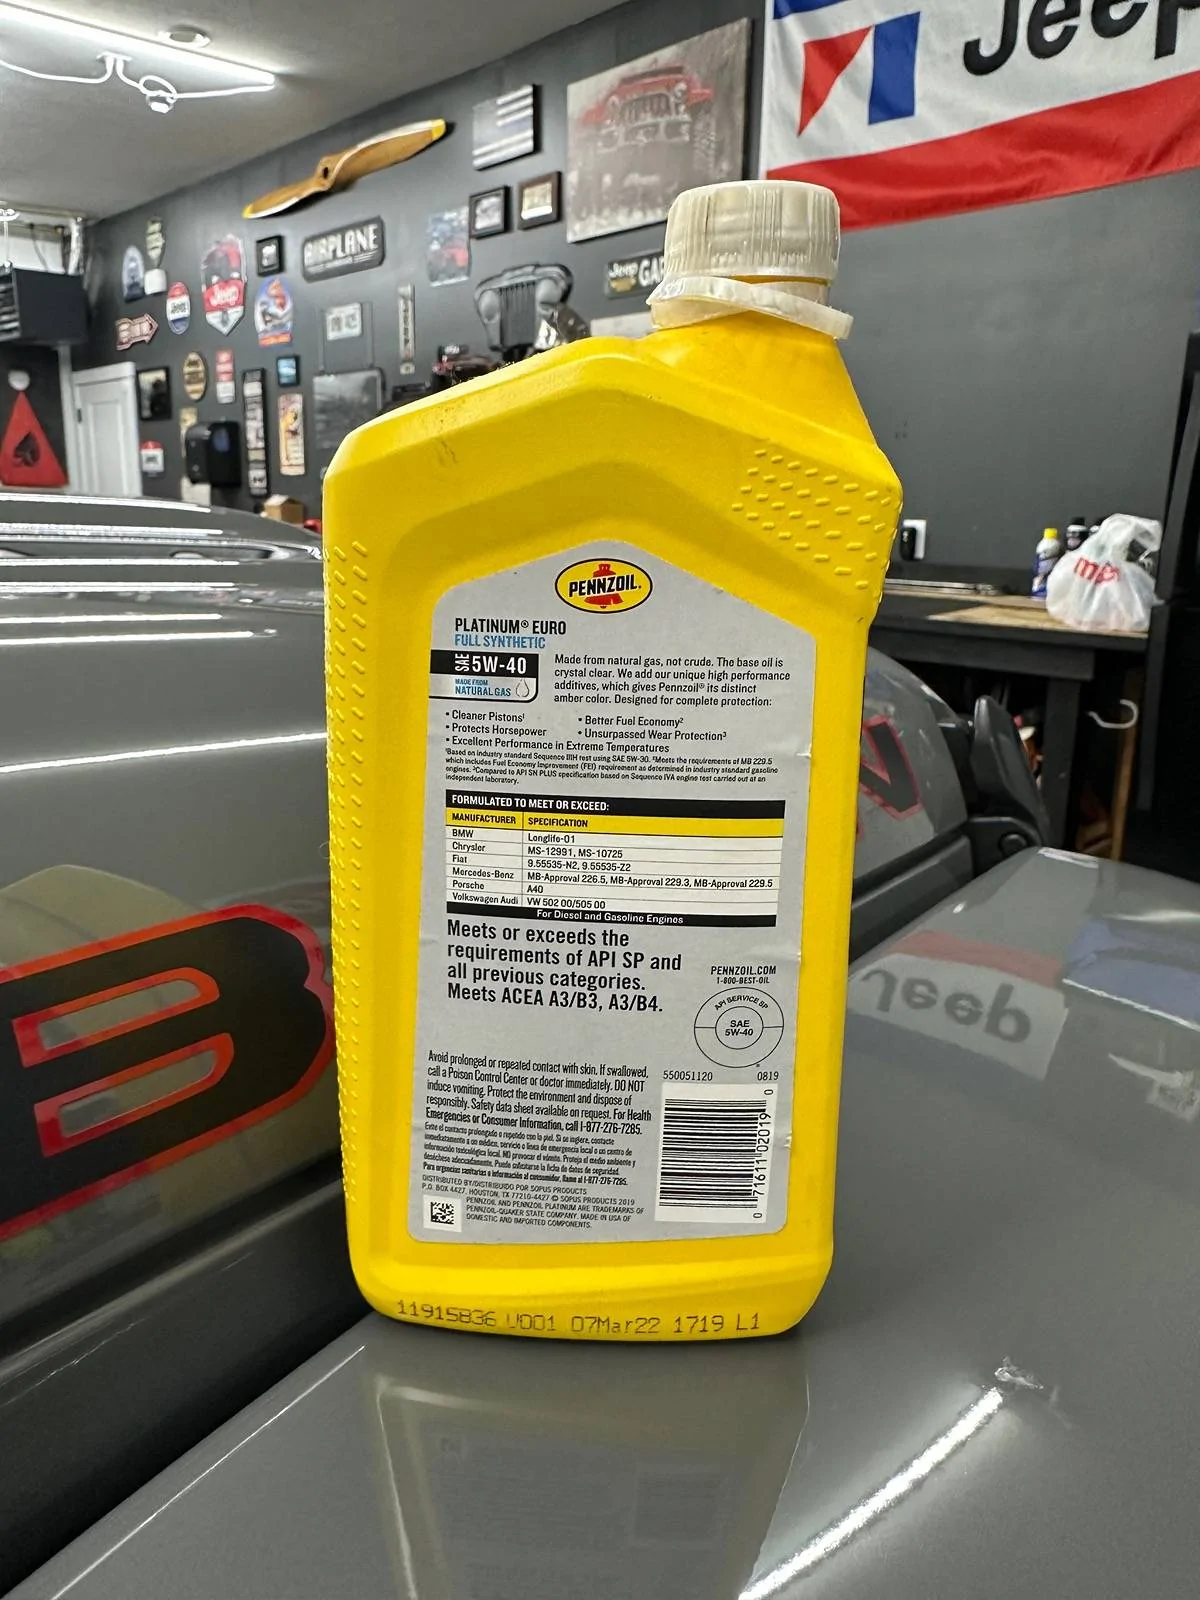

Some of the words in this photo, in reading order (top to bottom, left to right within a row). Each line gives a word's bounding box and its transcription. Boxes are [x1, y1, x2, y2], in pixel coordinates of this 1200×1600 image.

[532, 620, 567, 635] EURO
[454, 633, 481, 647] FULL
[483, 635, 546, 649] SYNTHETIC
[454, 653, 470, 672] SAE
[472, 655, 527, 674] 5W-40
[554, 654, 581, 665] Made
[583, 654, 605, 665] from
[607, 655, 641, 666] natural
[644, 657, 664, 669] gas,
[666, 657, 682, 666] not
[684, 656, 714, 667] crude.
[717, 656, 735, 667] The
[736, 657, 759, 668] base
[761, 658, 773, 668] oil
[775, 658, 784, 668] is
[554, 668, 587, 680] crystal
[588, 668, 615, 679] clear.
[617, 669, 633, 679] We
[635, 669, 653, 679] add
[654, 671, 671, 679] our
[673, 670, 706, 682] unique
[707, 670, 729, 682] high
[730, 671, 791, 682] performance
[455, 686, 494, 696] NATURAL
[495, 687, 512, 697] GAS
[554, 682, 600, 692] additives,
[602, 682, 630, 692] which
[631, 682, 657, 694] gives
[707, 683, 719, 693] its
[721, 683, 757, 693] distinct
[554, 694, 584, 703] amber
[585, 694, 612, 704] color.
[614, 694, 658, 706] Designed
[660, 695, 674, 705] for
[675, 696, 719, 707] complete
[720, 696, 772, 708] protection:
[451, 710, 486, 721] Cleaner
[584, 716, 613, 726] Better
[616, 716, 636, 726] Fuel
[452, 723, 490, 734] Protects
[492, 725, 547, 737] Horsepower
[584, 729, 646, 741] Unsurpassed
[648, 730, 672, 740] Wear
[452, 735, 493, 747] Excellent
[495, 738, 553, 750] Performance
[555, 740, 564, 750] in
[566, 740, 604, 751] Extreme
[606, 742, 670, 753] Temperatures
[445, 773, 484, 783] independent
[485, 776, 520, 786] laboratory.
[452, 794, 513, 807] FORMULATED
[514, 799, 527, 808] TO
[528, 799, 555, 809] MEET
[556, 801, 569, 810] OR
[570, 801, 610, 811] EXCEED:
[452, 813, 516, 824] MANUFACTURER
[528, 818, 588, 828] SPECIFICATION
[452, 829, 474, 838] BMW
[528, 833, 575, 843] Longlife-01
[452, 842, 486, 853] Chrysler
[527, 846, 576, 858] MS-12991,
[578, 849, 623, 859] MS-10725
[452, 855, 468, 863] Fiat
[527, 859, 580, 871] 9.55535-N2,
[581, 862, 631, 872] 9.55535-Z2
[452, 867, 514, 880] Mercedes-Benz
[527, 872, 580, 884] MB-Approval
[581, 875, 608, 885] 226.5,
[610, 876, 664, 887] MB-Approval
[664, 878, 692, 888] 229.3,
[693, 878, 747, 889] MB-Approval
[748, 879, 773, 888] 229.5
[452, 880, 485, 890] Porsche
[527, 885, 544, 894] A40
[452, 892, 499, 904] Volkswagen
[500, 895, 519, 905] Audi
[527, 898, 542, 906] VW
[542, 899, 559, 907] 502
[560, 899, 592, 909] 00/505
[593, 900, 606, 909] 00
[536, 910, 553, 919] For
[553, 911, 583, 920] Diesel
[584, 912, 602, 921] and
[604, 913, 644, 922] Gasoline
[646, 914, 684, 925] Engines
[447, 919, 497, 940] Meets
[502, 925, 520, 941] or
[525, 927, 596, 946] exceeds
[601, 929, 630, 947] the
[447, 944, 560, 966] requirements
[565, 949, 583, 967] of
[587, 950, 616, 968] API
[622, 951, 645, 969] SP
[649, 954, 682, 971] and
[447, 963, 467, 979] all
[473, 966, 544, 985] previous
[550, 972, 646, 991] categories.
[710, 965, 777, 976] PENNZOIL.COM
[716, 976, 770, 985] 1-800-BEST-OIL
[447, 982, 496, 1002] Meets
[501, 987, 544, 1006] ACEA
[548, 990, 603, 1012] A3/B3,
[608, 993, 663, 1012] A3/B4.
[714, 999, 727, 1011] API
[727, 994, 760, 1005] SERVICE
[730, 1020, 750, 1028] SAE
[724, 1028, 754, 1036] 5W-40
[428, 1050, 448, 1064] Avoid
[450, 1055, 487, 1069] prolonged
[488, 1058, 496, 1068] or
[498, 1058, 531, 1074] repeated
[532, 1062, 561, 1073] contact
[562, 1063, 578, 1075] with
[580, 1063, 598, 1076] skin.
[599, 1065, 605, 1076] If
[606, 1065, 649, 1079] swallowed,
[662, 1070, 713, 1081] 550051120
[757, 1071, 779, 1081] 0819
[426, 1107, 471, 1124] Emergencies
[472, 1113, 480, 1124] or
[481, 1113, 518, 1128] Consumer
[519, 1117, 564, 1132] Information,
[565, 1119, 579, 1131] call
[580, 1121, 643, 1135] 1-877-276-7285.
[571, 1315, 661, 1334] 07Mar22
[673, 1315, 725, 1333] 1719
[736, 1312, 760, 1331] L1
